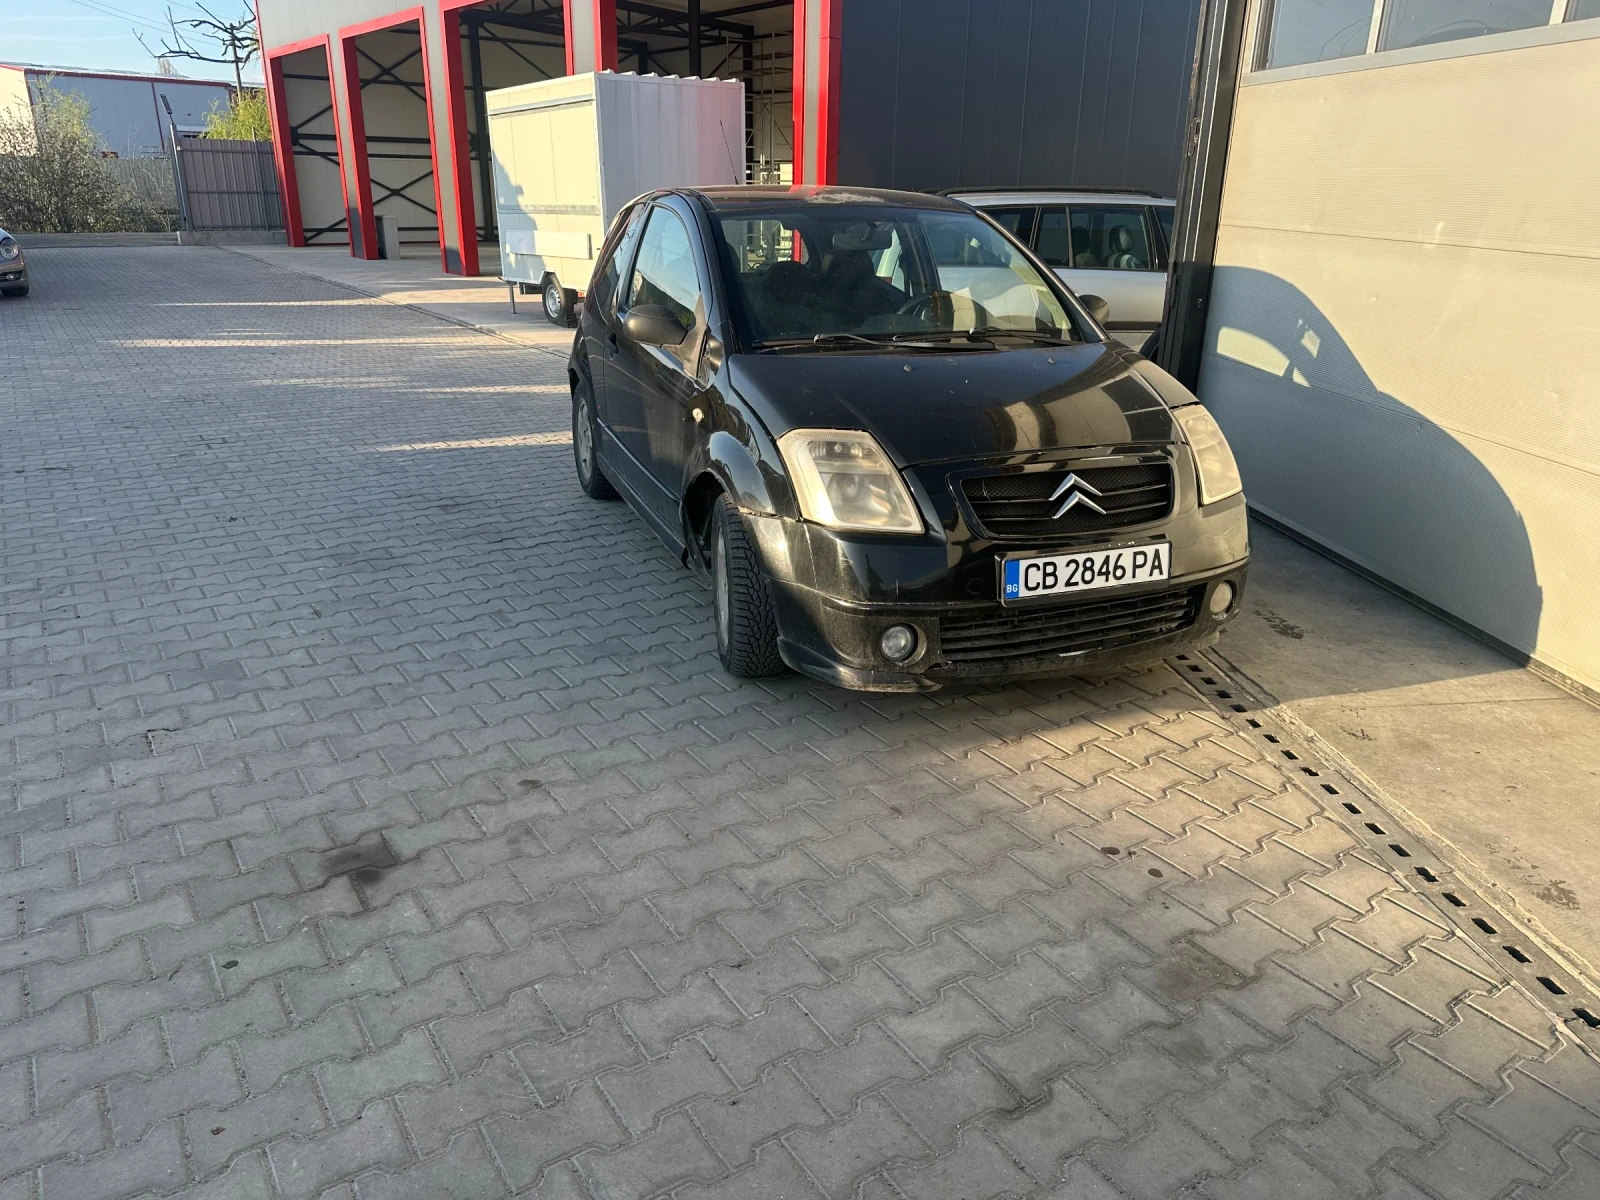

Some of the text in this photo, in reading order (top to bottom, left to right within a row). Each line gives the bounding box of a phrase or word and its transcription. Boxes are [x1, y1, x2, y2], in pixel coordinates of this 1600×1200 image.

[1024, 548, 1164, 591] CB 2846 PA
[1006, 583, 1018, 594] BG
